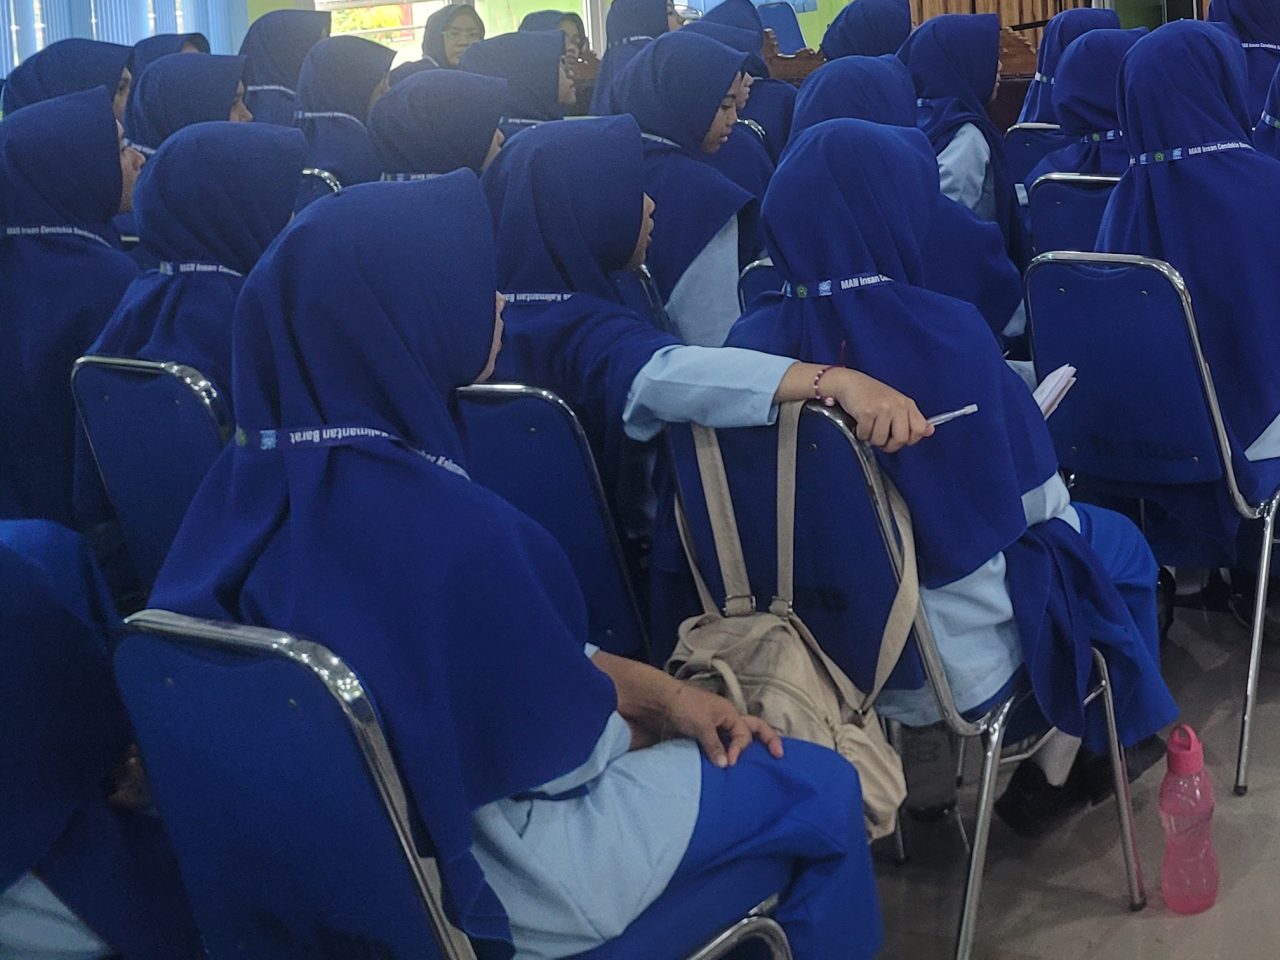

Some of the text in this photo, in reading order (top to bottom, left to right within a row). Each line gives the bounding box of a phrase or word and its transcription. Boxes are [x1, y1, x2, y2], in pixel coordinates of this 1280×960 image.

[1188, 146, 1202, 156] MAN
[1202, 145, 1218, 154] Insan
[1217, 142, 1240, 151] Cendekia
[840, 277, 860, 291] MAN
[860, 275, 880, 287] Insan
[289, 429, 321, 445] Barat
